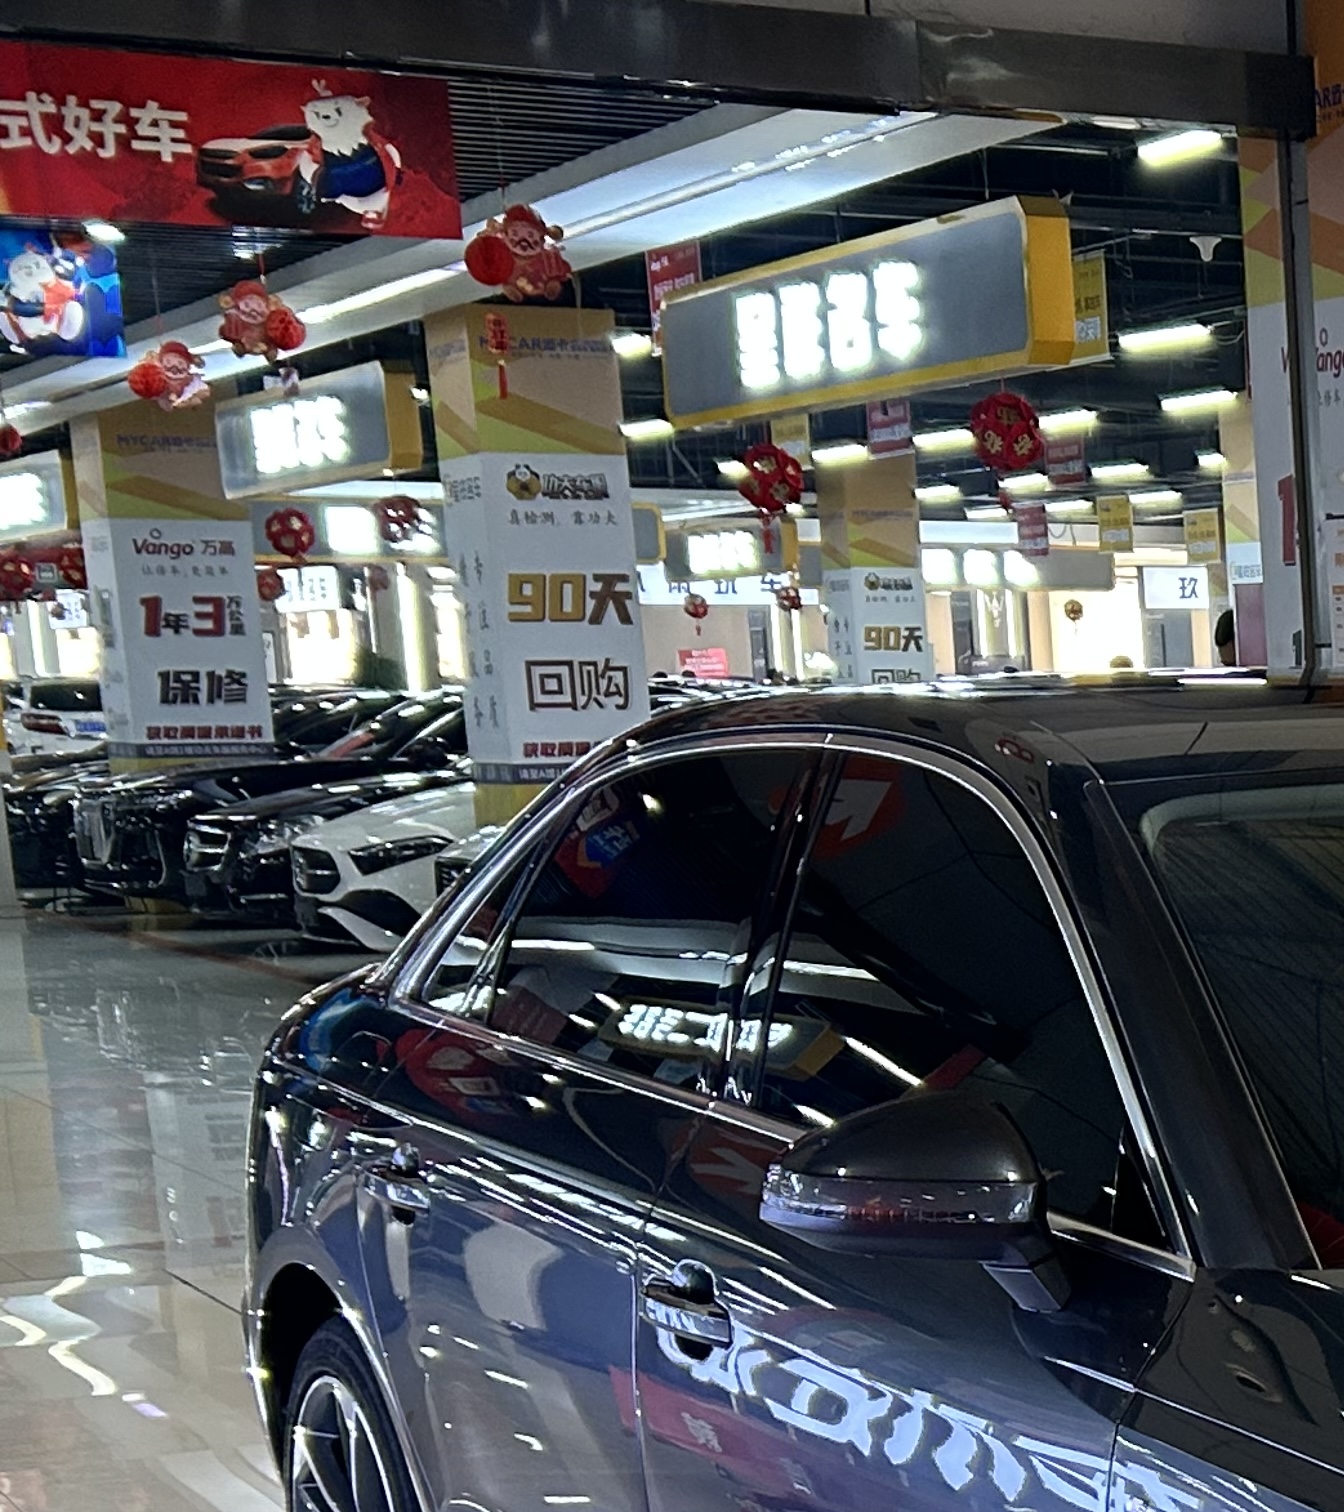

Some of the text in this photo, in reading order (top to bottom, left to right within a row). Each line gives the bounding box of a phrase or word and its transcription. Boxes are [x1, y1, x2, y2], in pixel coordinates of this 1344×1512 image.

[0, 91, 193, 162] 式好车
[132, 537, 194, 560] Vango
[507, 573, 634, 625] 90天
[864, 627, 924, 652] 90天
[157, 669, 248, 705] 保修
[525, 658, 632, 712] 回购
